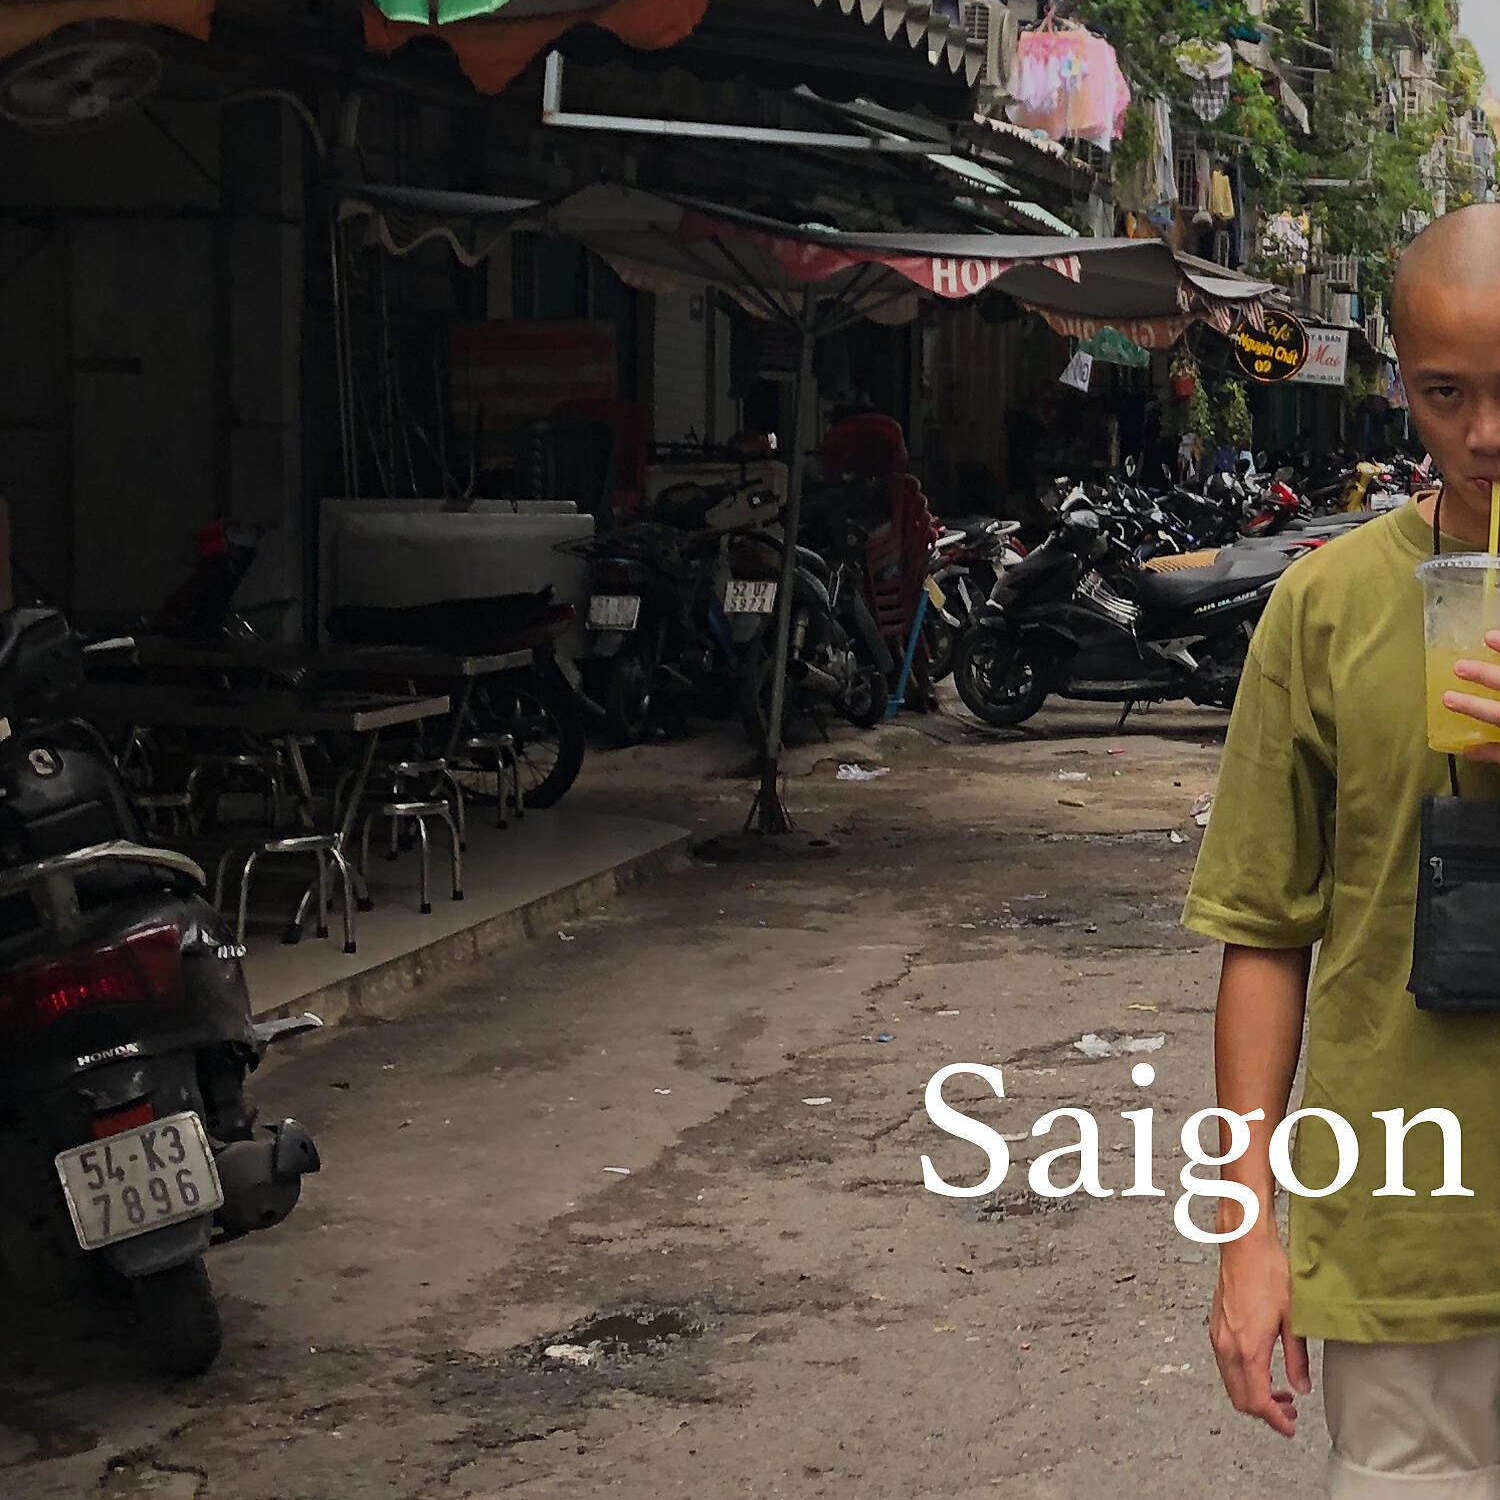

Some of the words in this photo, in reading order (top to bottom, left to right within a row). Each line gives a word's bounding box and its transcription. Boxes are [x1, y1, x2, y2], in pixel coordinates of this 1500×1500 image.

[77, 1042, 140, 1067] HONDA
[80, 1125, 186, 1190] 54-K3
[93, 1169, 199, 1236] 7896
